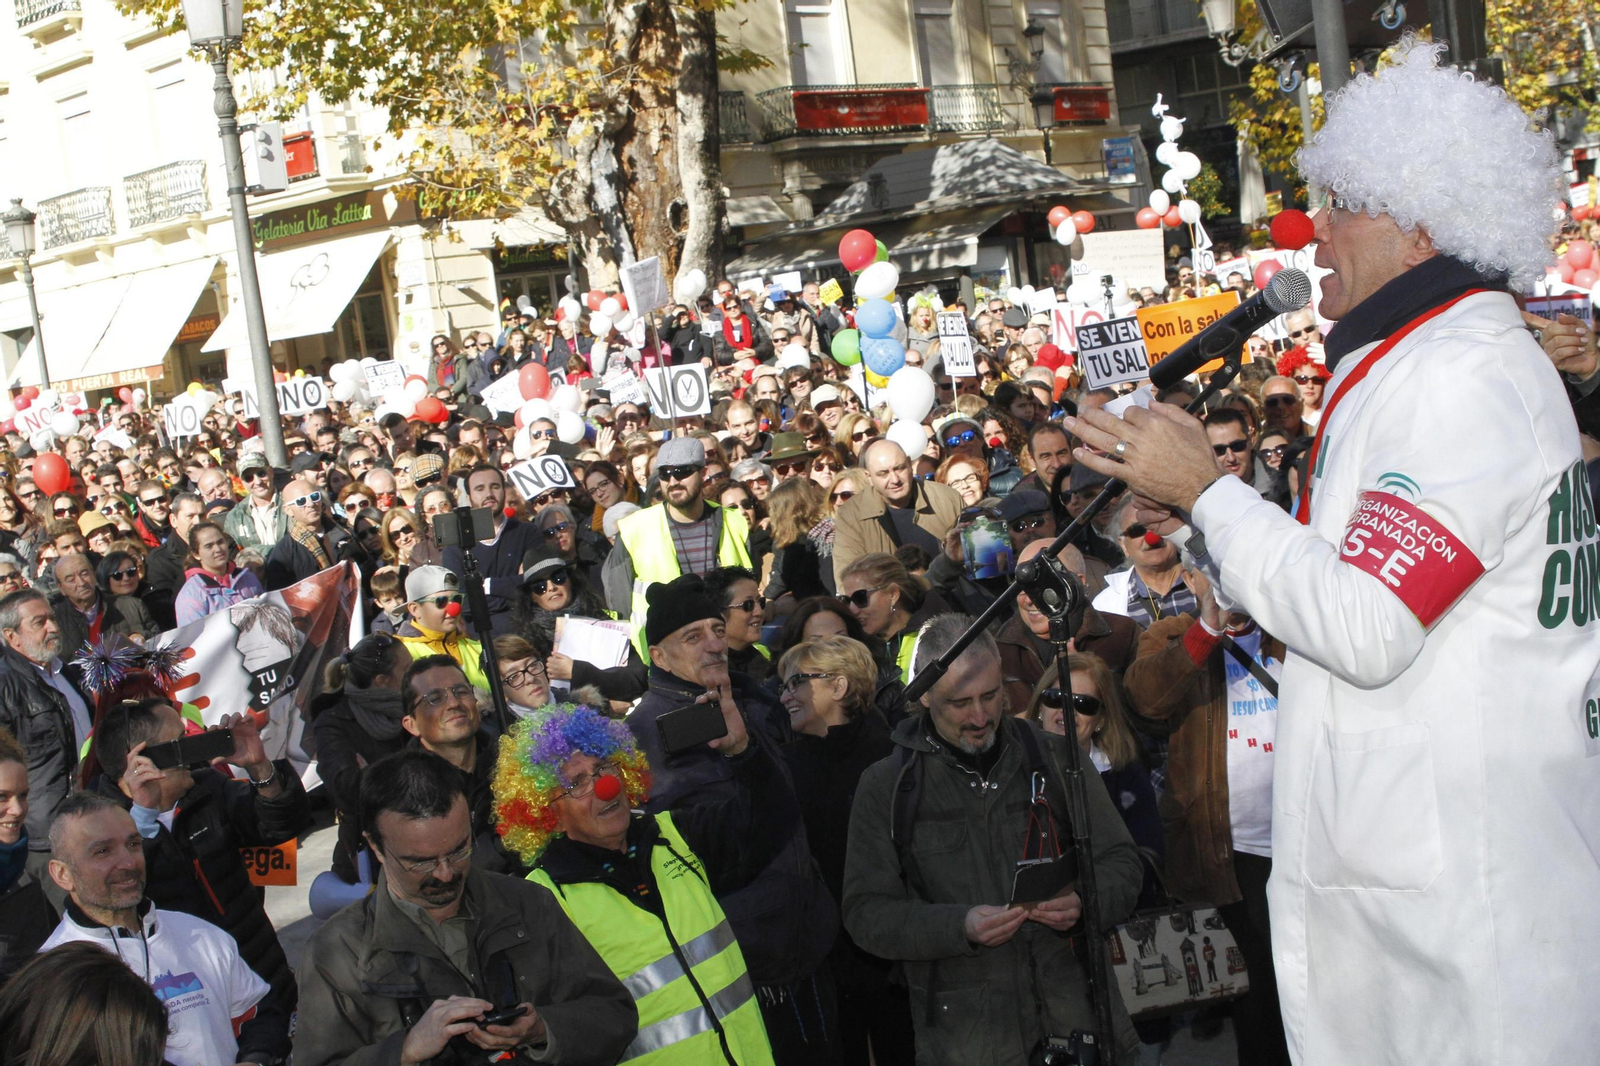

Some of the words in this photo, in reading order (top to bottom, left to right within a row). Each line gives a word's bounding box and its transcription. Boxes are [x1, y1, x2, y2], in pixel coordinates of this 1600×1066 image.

[307, 208, 329, 232] Via
[331, 202, 373, 226] Lattea
[1079, 327, 1102, 349] SE
[1144, 317, 1176, 340] Con
[1179, 314, 1193, 334] la
[1088, 350, 1112, 380] TU
[71, 373, 115, 393] PUERTA
[119, 368, 149, 384] REAL
[644, 368, 705, 417] NO
[281, 380, 323, 412] NO
[24, 407, 52, 433] NO
[166, 404, 198, 435] NO
[512, 457, 569, 497] NO
[256, 668, 277, 687] TU
[1228, 728, 1239, 740] H
[1246, 737, 1258, 748] H
[1262, 741, 1274, 753] H
